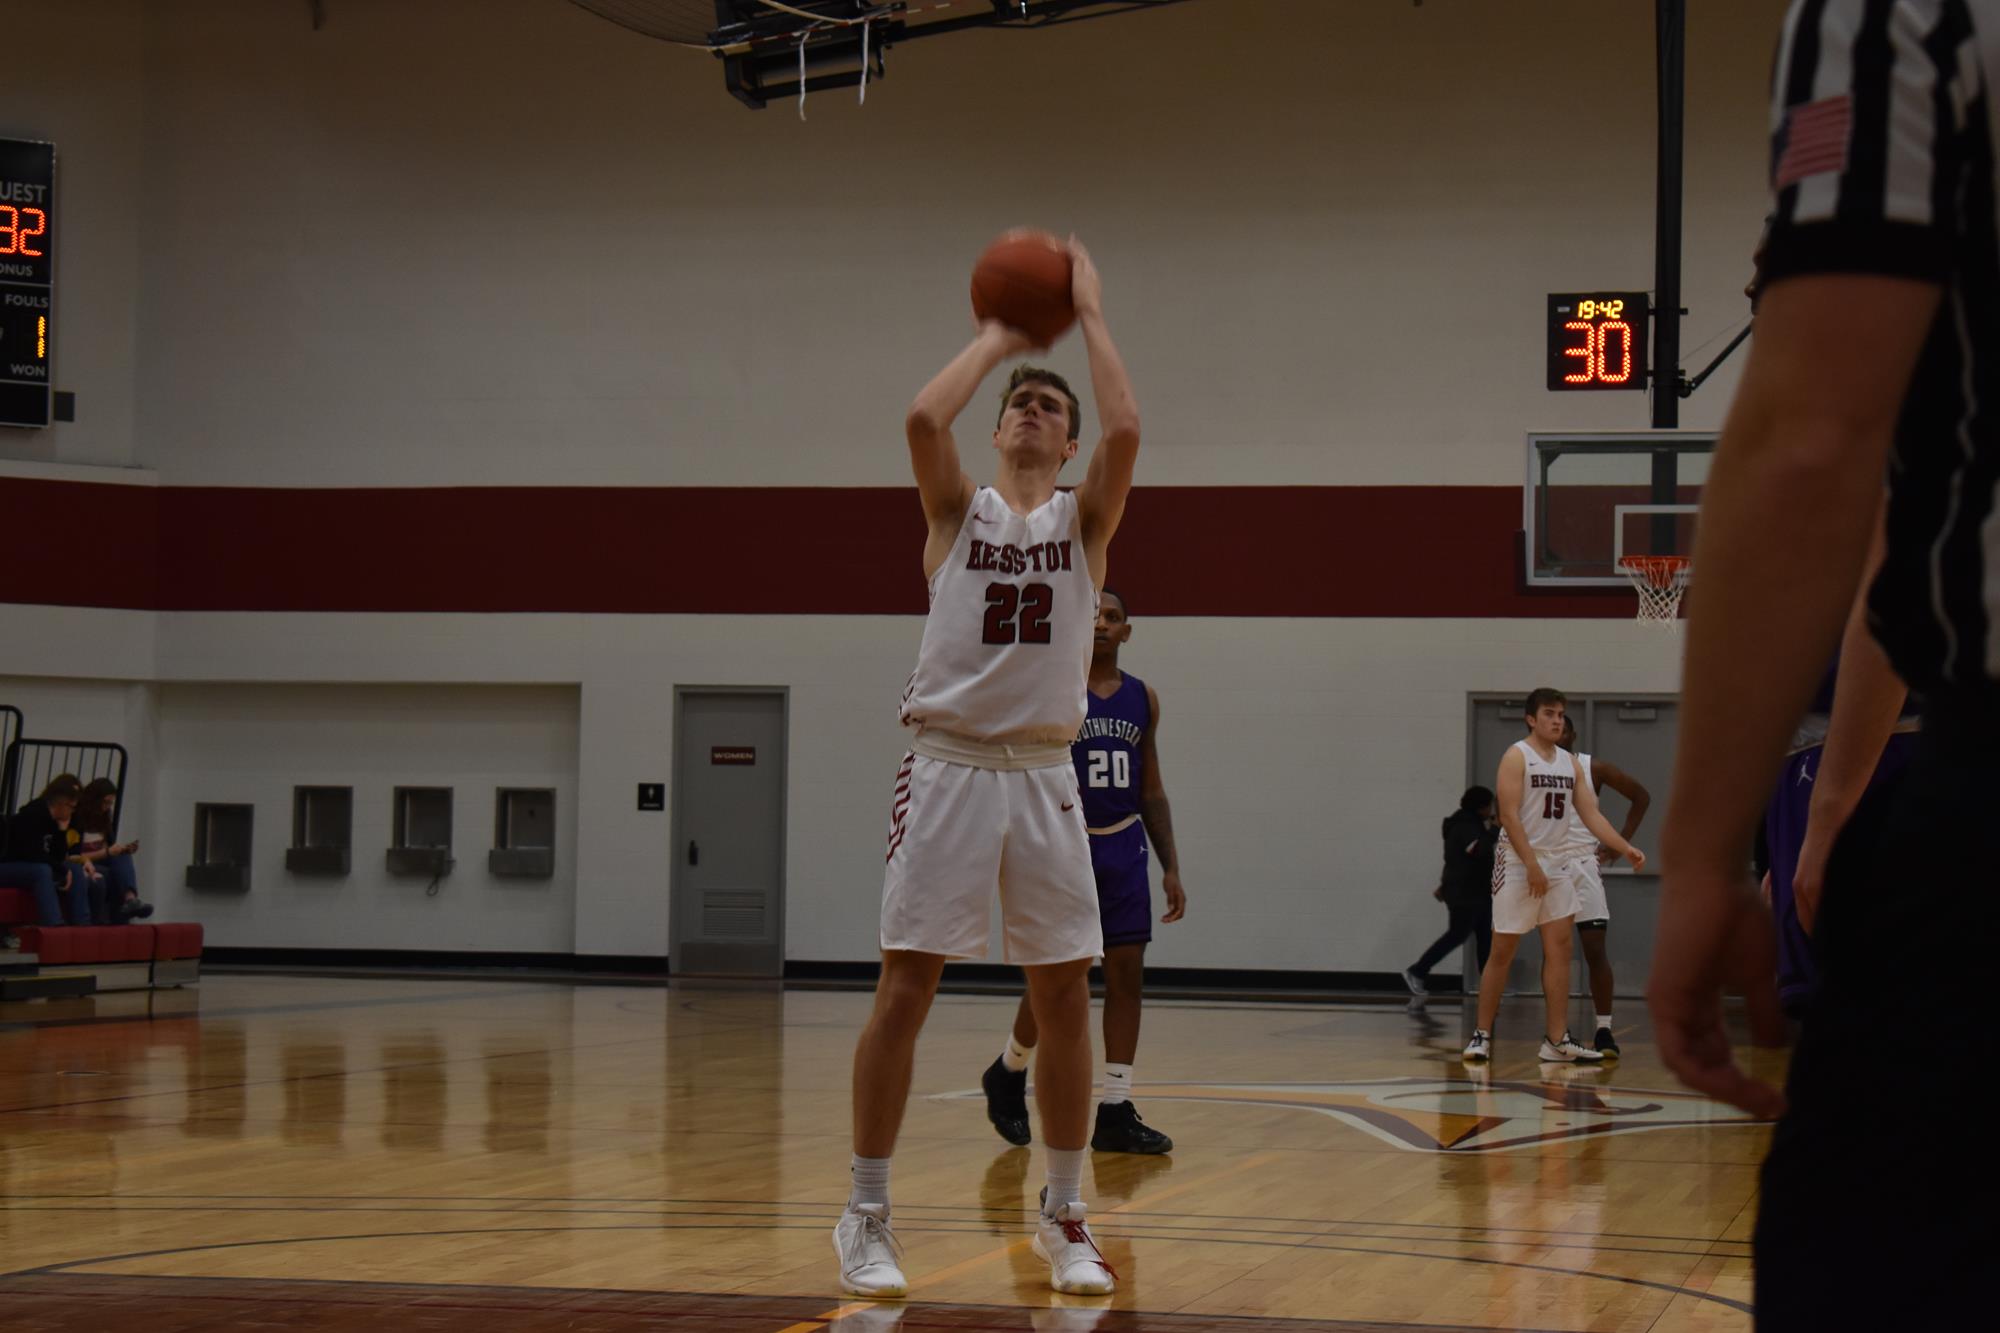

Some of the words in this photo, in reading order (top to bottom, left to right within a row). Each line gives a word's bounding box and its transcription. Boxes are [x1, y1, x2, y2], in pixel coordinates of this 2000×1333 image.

[5, 294, 49, 308] FOULS
[1578, 300, 1623, 319] 19:42
[37, 315, 46, 358] 1
[1565, 321, 1630, 382] 30
[10, 364, 46, 377] WON
[966, 539, 1071, 575] HESSTON
[982, 582, 1053, 644] 22
[713, 752, 753, 760] WOMEN
[1087, 749, 1130, 788] 20
[1543, 792, 1566, 820] 15
